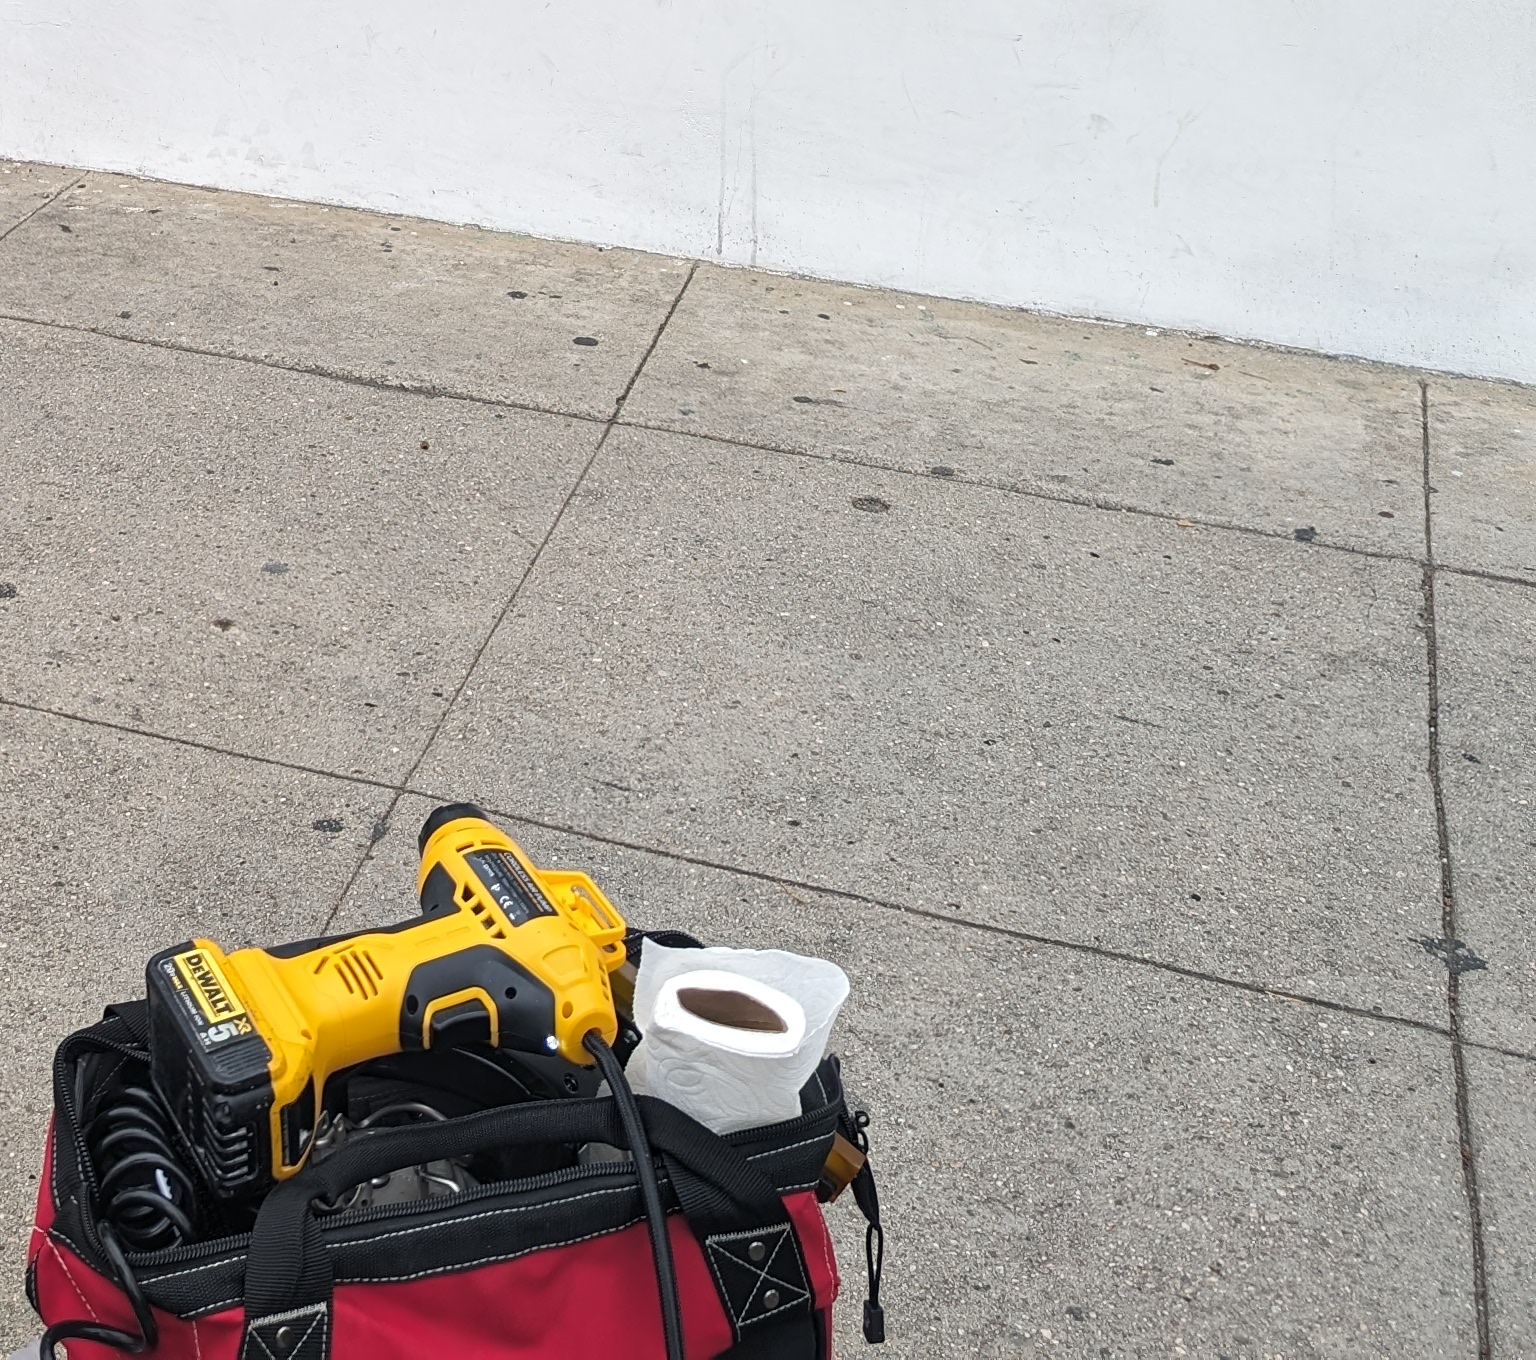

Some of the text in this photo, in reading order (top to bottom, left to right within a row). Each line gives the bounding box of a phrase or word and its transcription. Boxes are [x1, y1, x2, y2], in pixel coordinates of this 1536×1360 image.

[504, 852, 530, 882] CORDLESS
[534, 892, 553, 913] PUMP
[180, 991, 205, 1026] LITHIUM ION
[207, 1022, 240, 1042] 5
[233, 1017, 252, 1035] XR
